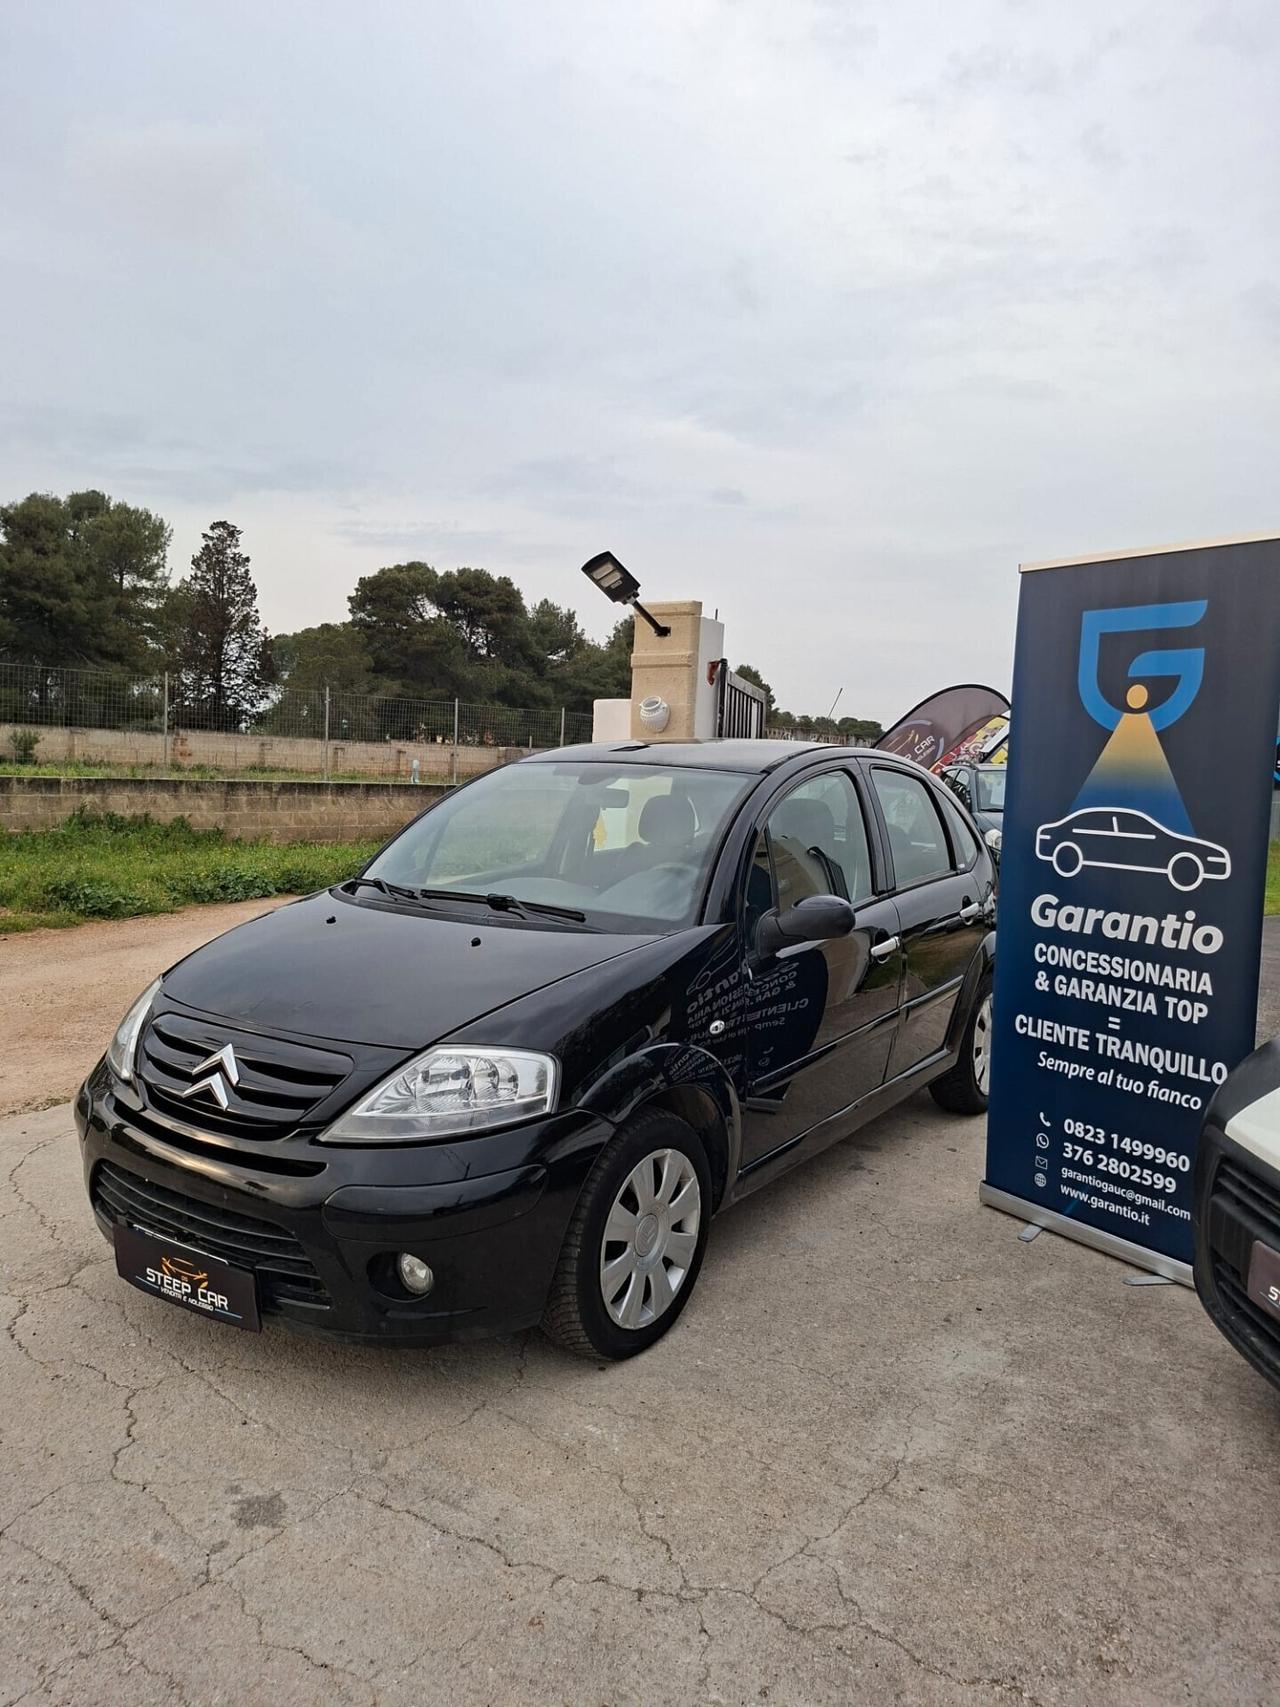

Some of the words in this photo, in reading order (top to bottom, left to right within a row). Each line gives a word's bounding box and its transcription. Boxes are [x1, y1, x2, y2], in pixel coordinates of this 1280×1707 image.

[914, 735, 935, 754] CAR
[1030, 894, 1224, 954] Garantio
[1034, 943, 1213, 996] CONCESSIONARIA
[1034, 971, 1050, 992] &
[1054, 975, 1157, 1015] GARANZIA
[1164, 996, 1208, 1024] TOP
[1015, 1014, 1090, 1051] CLIENTE
[1096, 1033, 1228, 1085] TRANQUILLO
[1037, 1051, 1095, 1079] Sempre
[1097, 1069, 1114, 1086] al
[1116, 1073, 1144, 1094] tuo
[1147, 1080, 1202, 1110] fianco
[1062, 1142, 1094, 1165] 376
[1097, 1154, 1177, 1193] 2802599
[1063, 1118, 1106, 1145] 0823
[1111, 1133, 1190, 1172] 1499960
[1060, 1183, 1150, 1226] www.garantio.it
[1061, 1167, 1191, 1221] garantiogauc@gmail.com
[146, 1267, 192, 1295] STEEP
[197, 1288, 229, 1311] CAR
